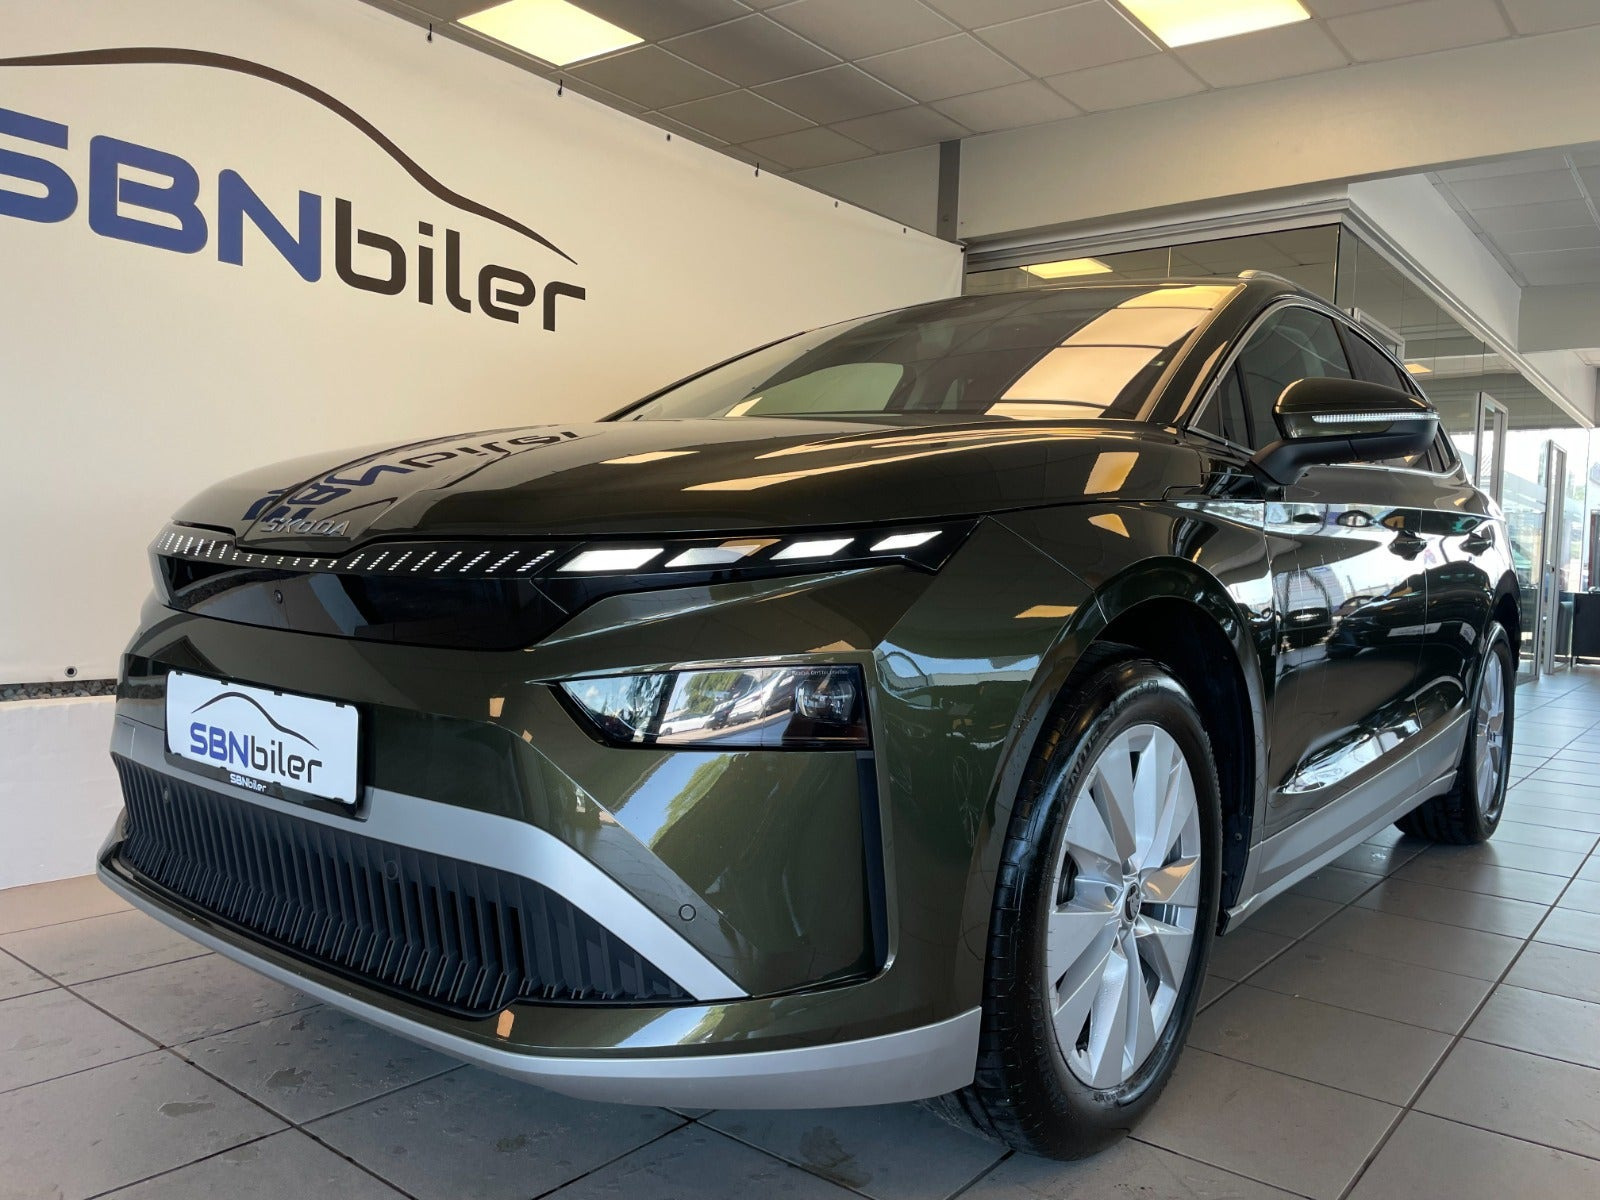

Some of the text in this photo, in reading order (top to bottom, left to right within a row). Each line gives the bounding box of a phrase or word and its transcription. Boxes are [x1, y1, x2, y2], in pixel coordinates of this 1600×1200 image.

[0, 108, 585, 331] SBNbiler
[190, 722, 322, 783] SBNbiler
[229, 773, 267, 792] SBNbiler
